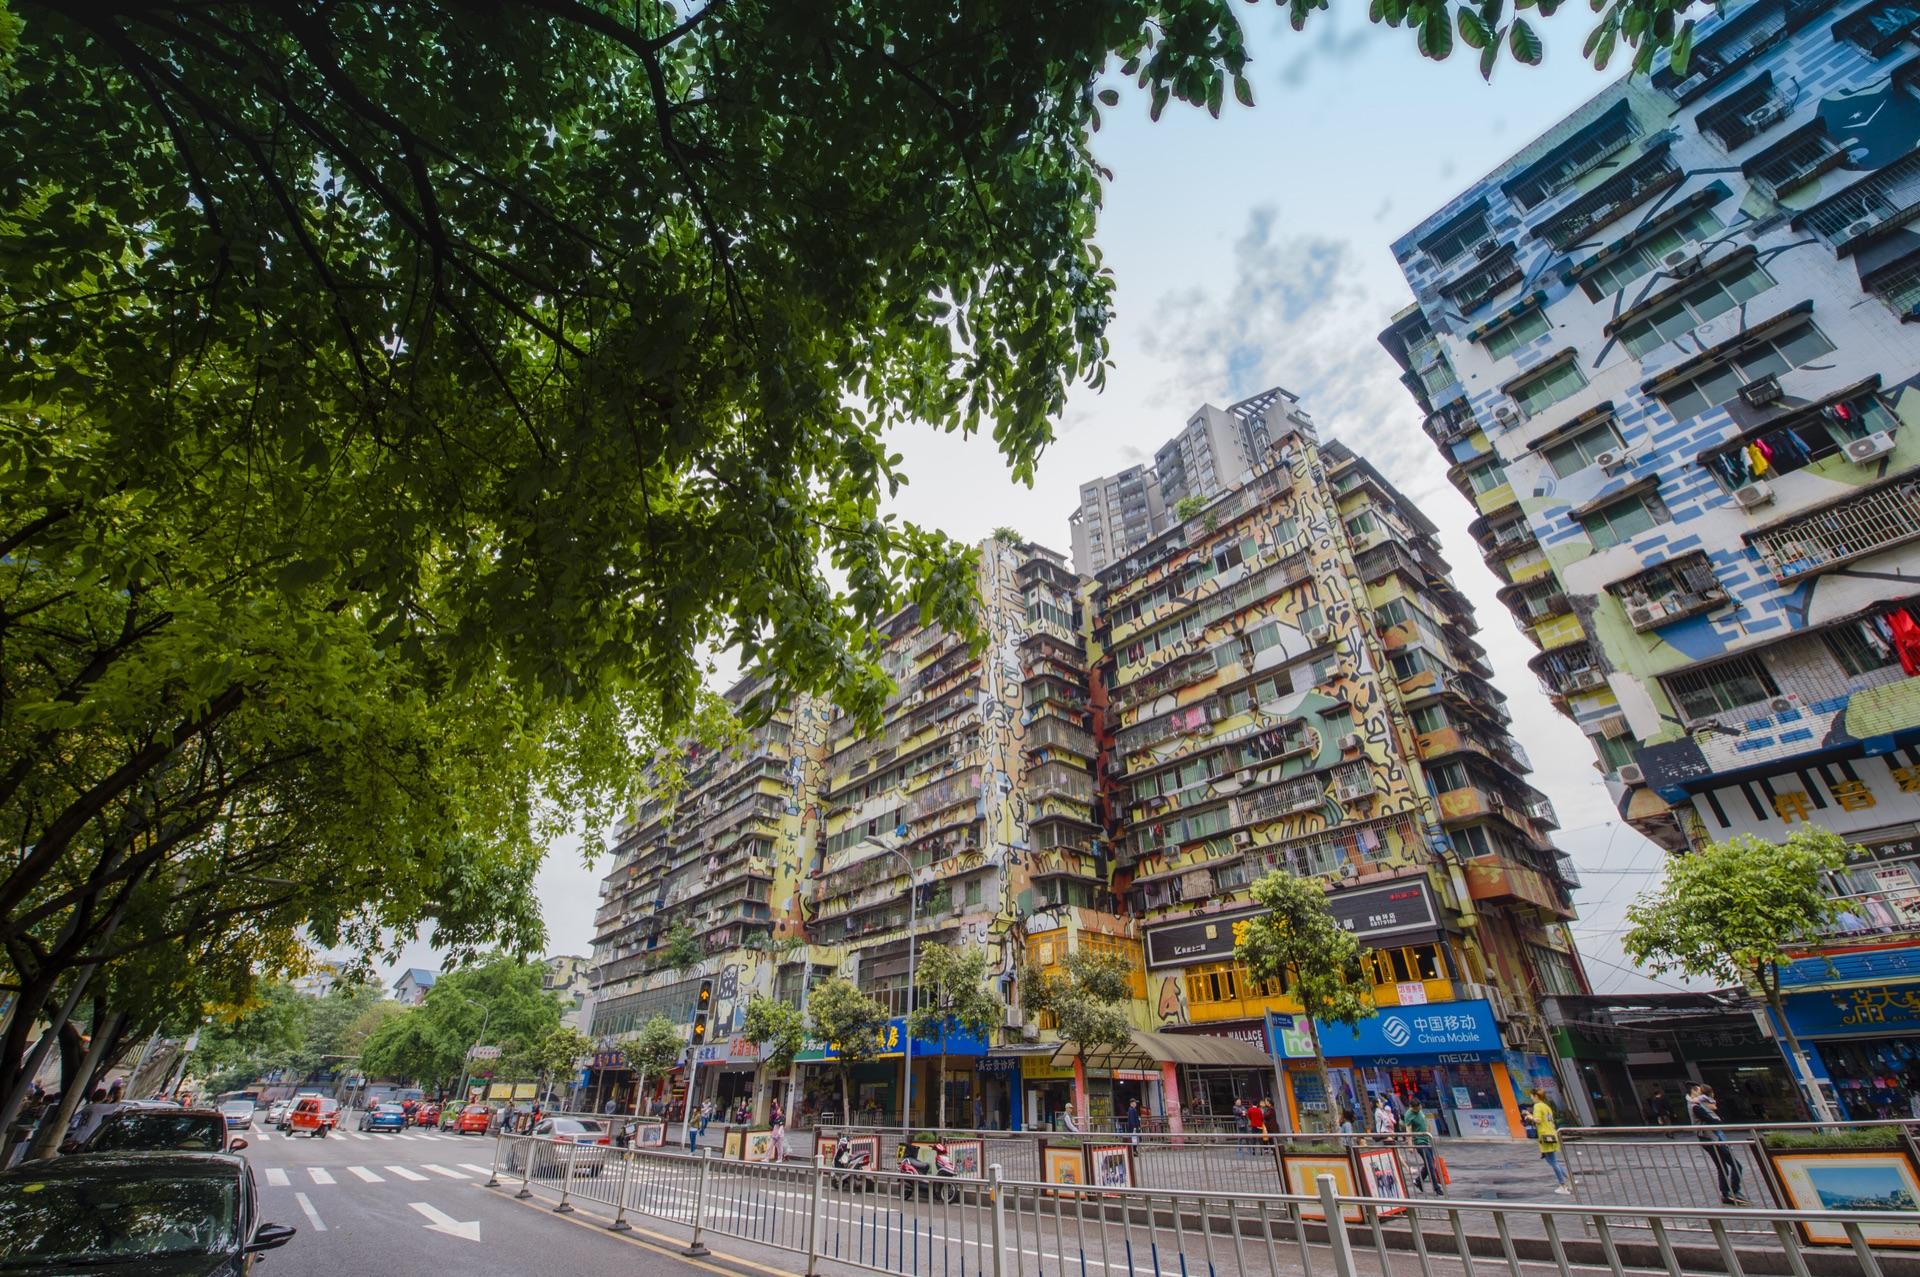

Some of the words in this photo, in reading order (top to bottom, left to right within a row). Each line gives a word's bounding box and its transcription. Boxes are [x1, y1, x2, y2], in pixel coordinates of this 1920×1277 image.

[1414, 1014, 1477, 1032] 中国移动
[1227, 1029, 1263, 1041] WALLACE
[1418, 1033, 1446, 1044] China
[1446, 1031, 1480, 1043] Mobile
[1438, 1052, 1480, 1063] MEIZU
[1478, 1119, 1490, 1128] 29
